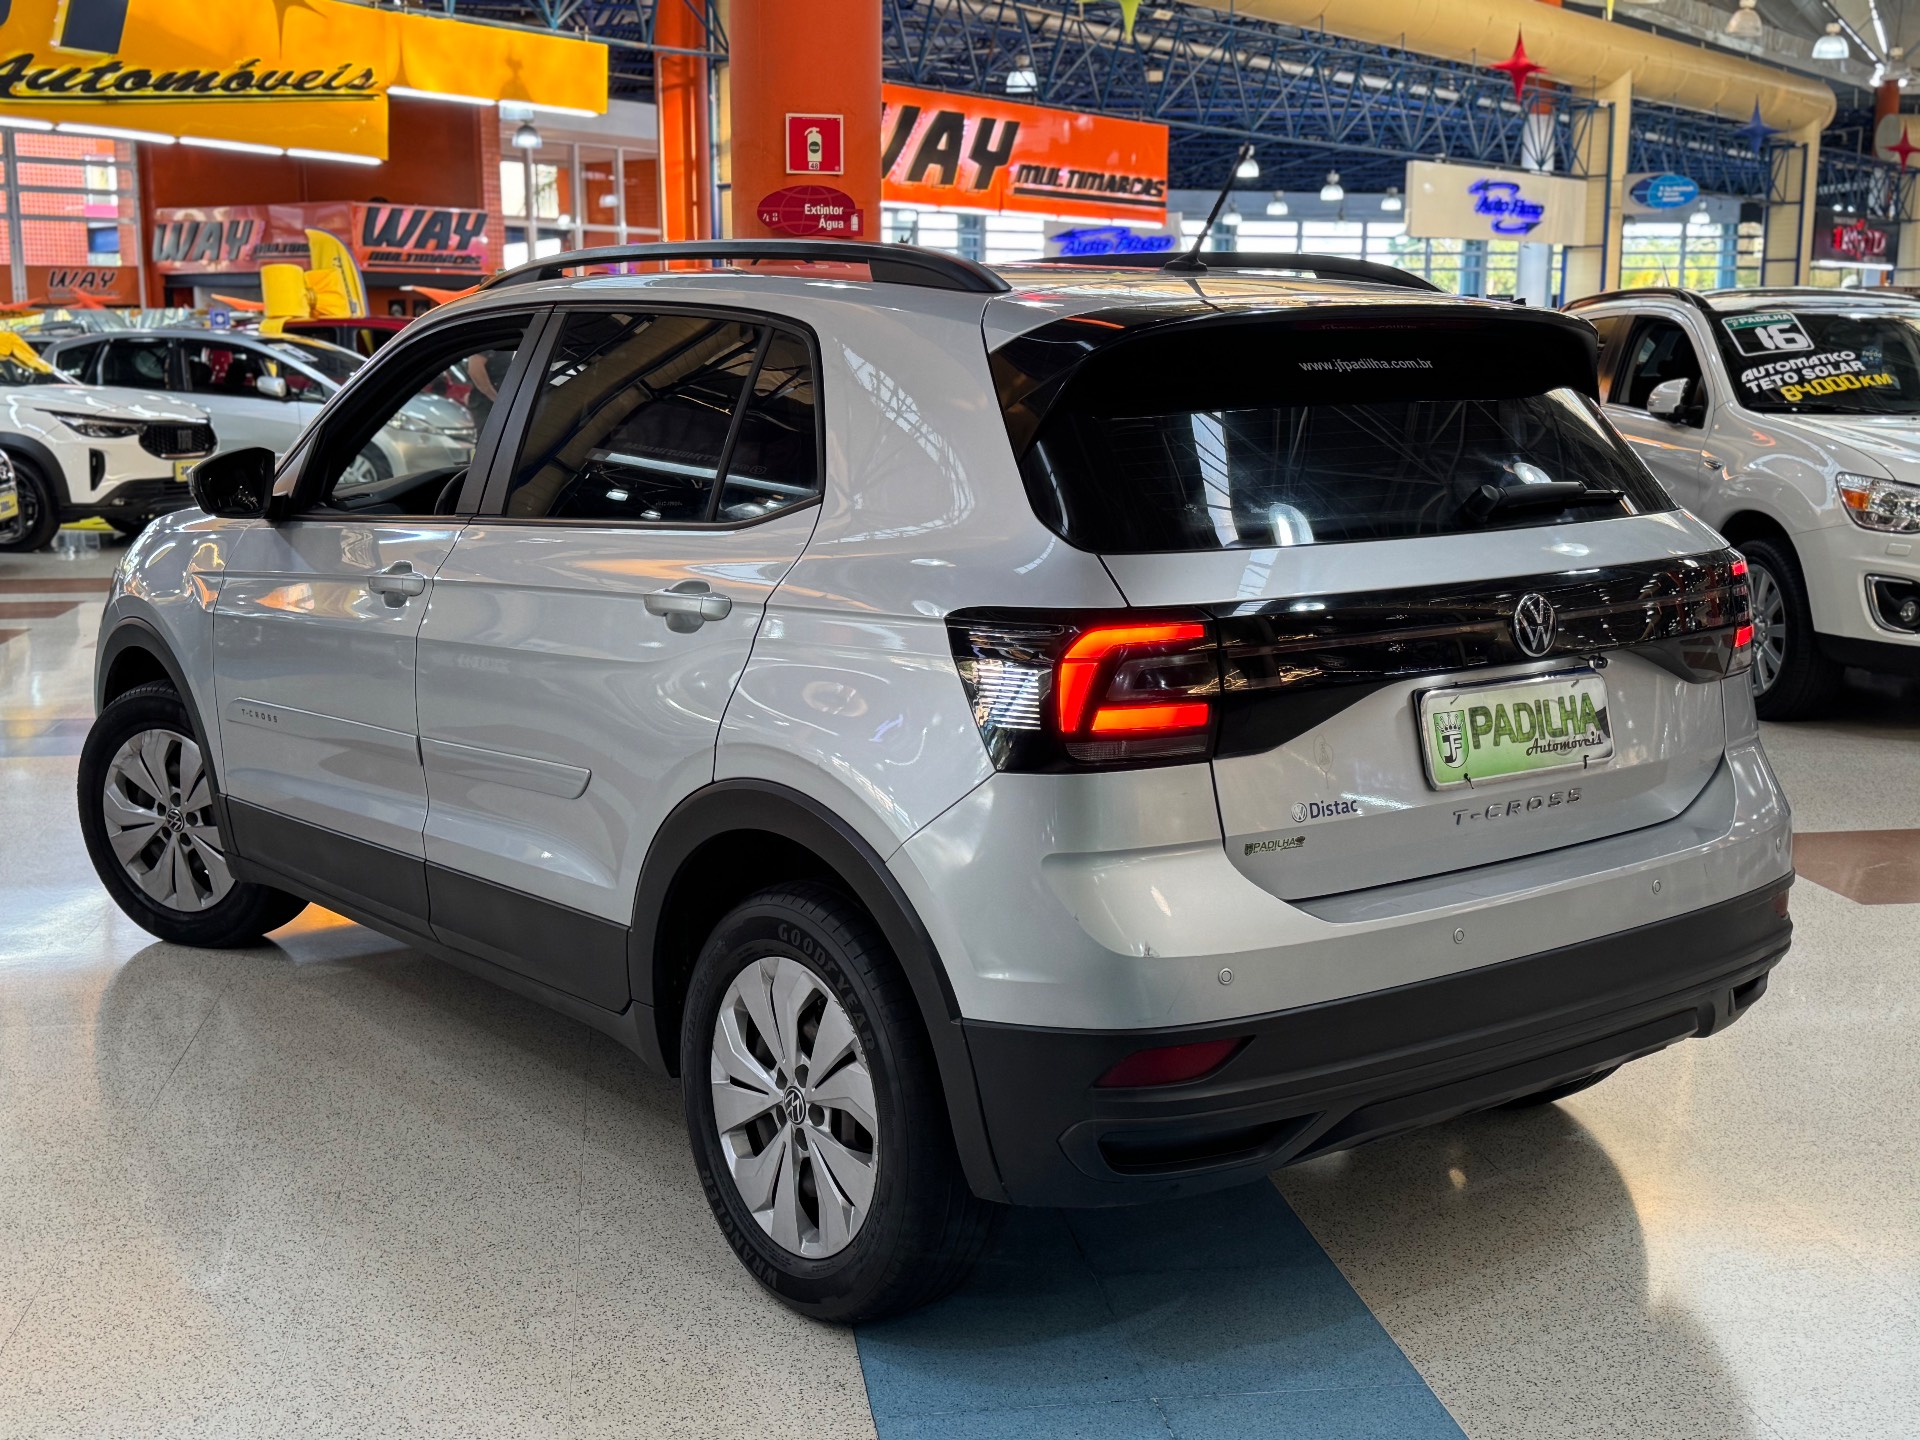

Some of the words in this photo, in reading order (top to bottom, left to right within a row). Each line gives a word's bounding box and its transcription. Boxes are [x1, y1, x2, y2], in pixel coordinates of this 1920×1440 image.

[0, 53, 379, 93] Automóveis
[809, 162, 819, 170] 48
[1015, 163, 1166, 198] MULTIMARCAS
[804, 203, 844, 215] Extintor
[362, 206, 489, 251] WAY
[818, 215, 844, 230] Água
[153, 219, 254, 262] WAY
[49, 270, 116, 289] WAY
[1739, 314, 1792, 324] PADILHA
[1754, 323, 1809, 350] 16
[1298, 357, 1434, 372] www.jfpadilha.com.br
[1746, 371, 1799, 394] TETO
[1801, 360, 1866, 380] SOLAR
[241, 708, 279, 723] T-CROSS
[1468, 692, 1601, 750] PADILHA
[1526, 731, 1604, 756] Automóveis
[1309, 799, 1359, 819] Distac
[1452, 787, 1583, 826] T-CROSS
[1253, 837, 1296, 851] PADILHA
[777, 922, 876, 1052] GOODYEAR
[701, 1167, 779, 1290] WRANGLER
